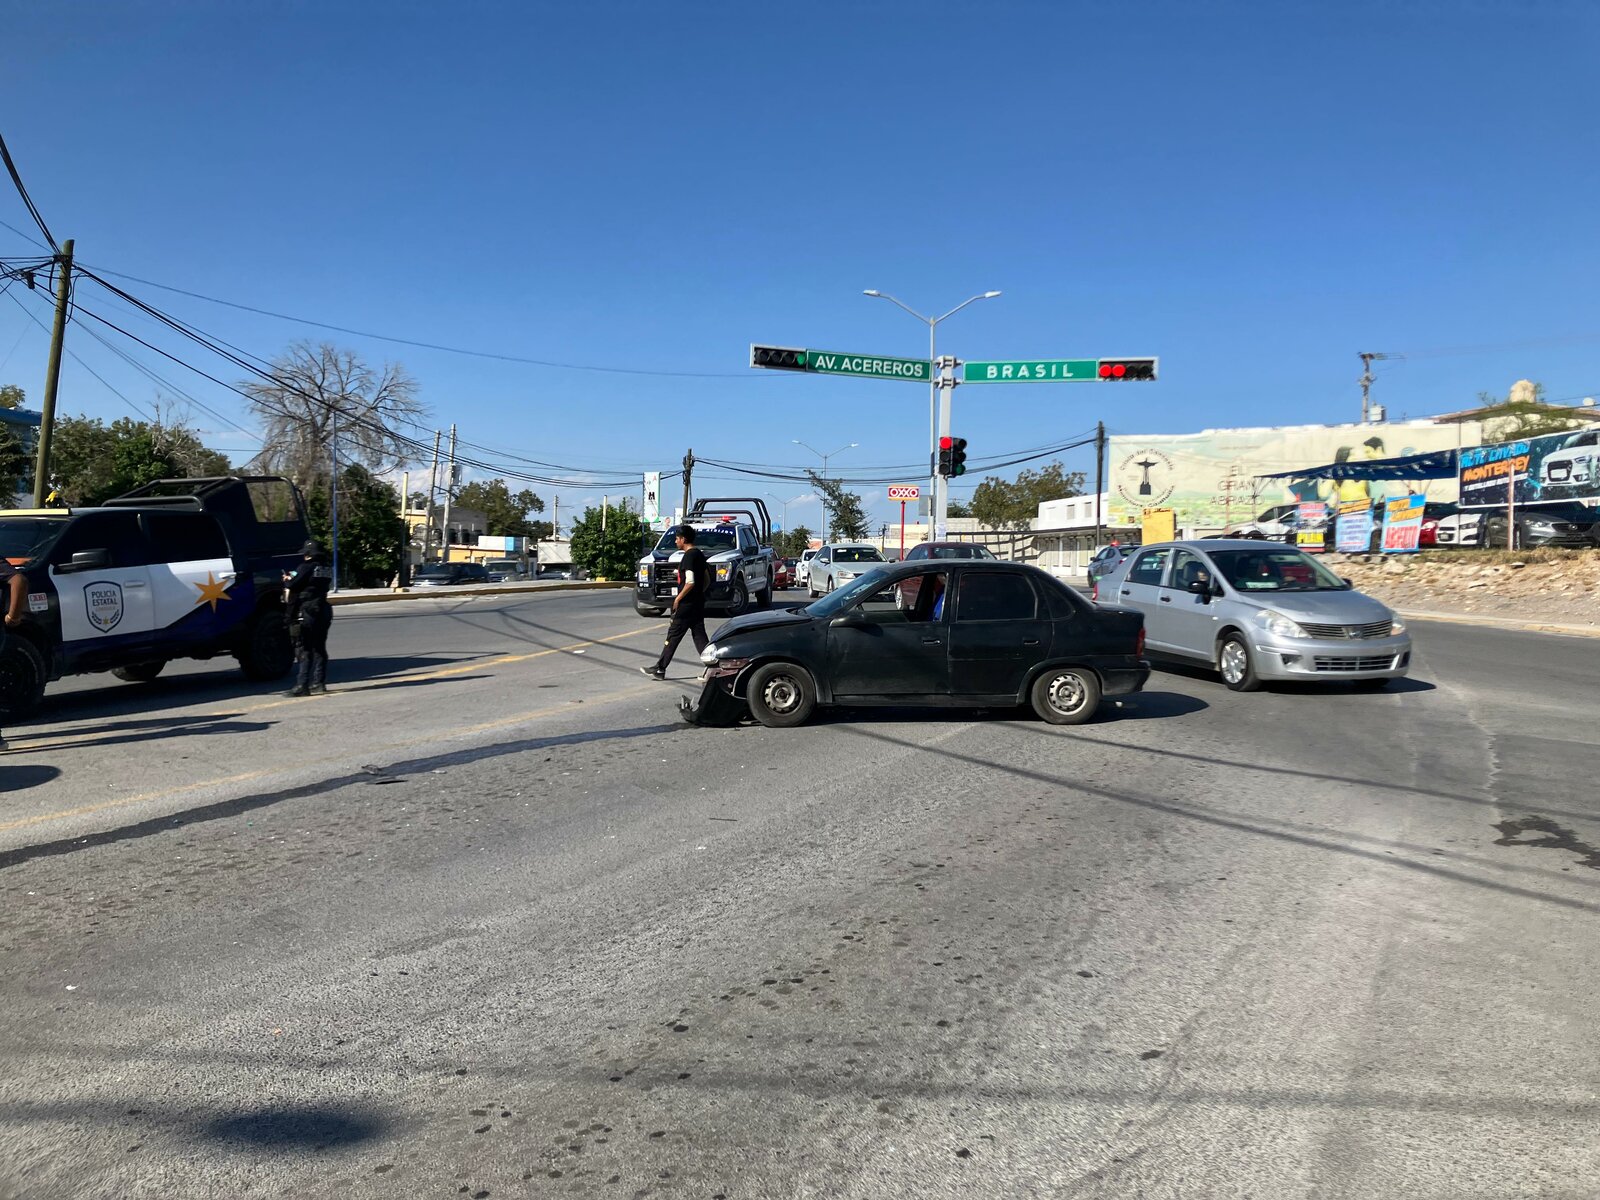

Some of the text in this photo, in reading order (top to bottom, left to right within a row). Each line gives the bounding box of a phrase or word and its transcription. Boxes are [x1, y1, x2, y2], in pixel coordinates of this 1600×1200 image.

[815, 355, 923, 377] AV. ACEREROS
[986, 363, 1074, 379] BRASIL
[889, 487, 918, 498] OXXO
[92, 598, 118, 607] ESTATAL
